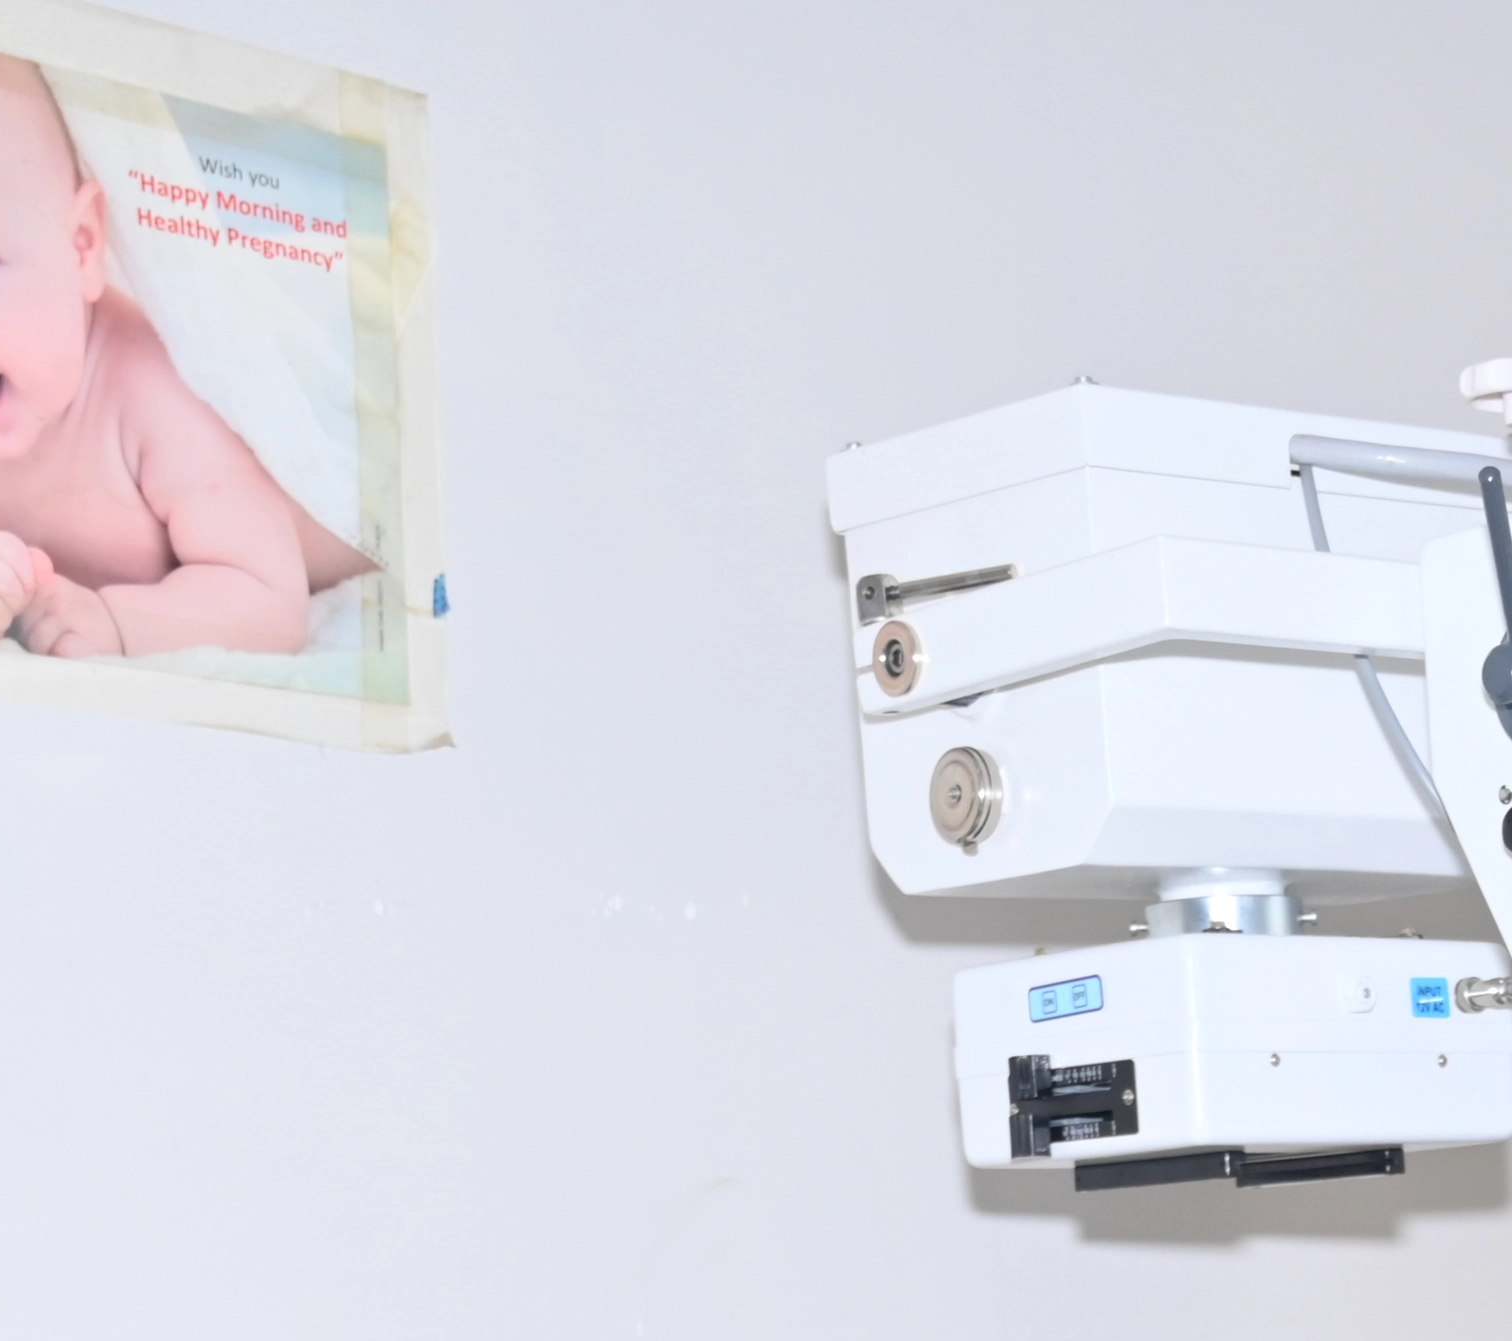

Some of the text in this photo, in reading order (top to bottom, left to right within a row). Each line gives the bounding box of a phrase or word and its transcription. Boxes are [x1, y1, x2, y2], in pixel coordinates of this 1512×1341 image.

[199, 156, 280, 190] Wish you
[217, 191, 305, 233] Morning
[312, 218, 348, 238] and
[137, 208, 220, 247] Healthy
[1074, 991, 1085, 1001] OFF
[1417, 986, 1441, 996] INPUT
[1044, 998, 1054, 1007] ON
[1417, 1003, 1444, 1013] 12V AC
